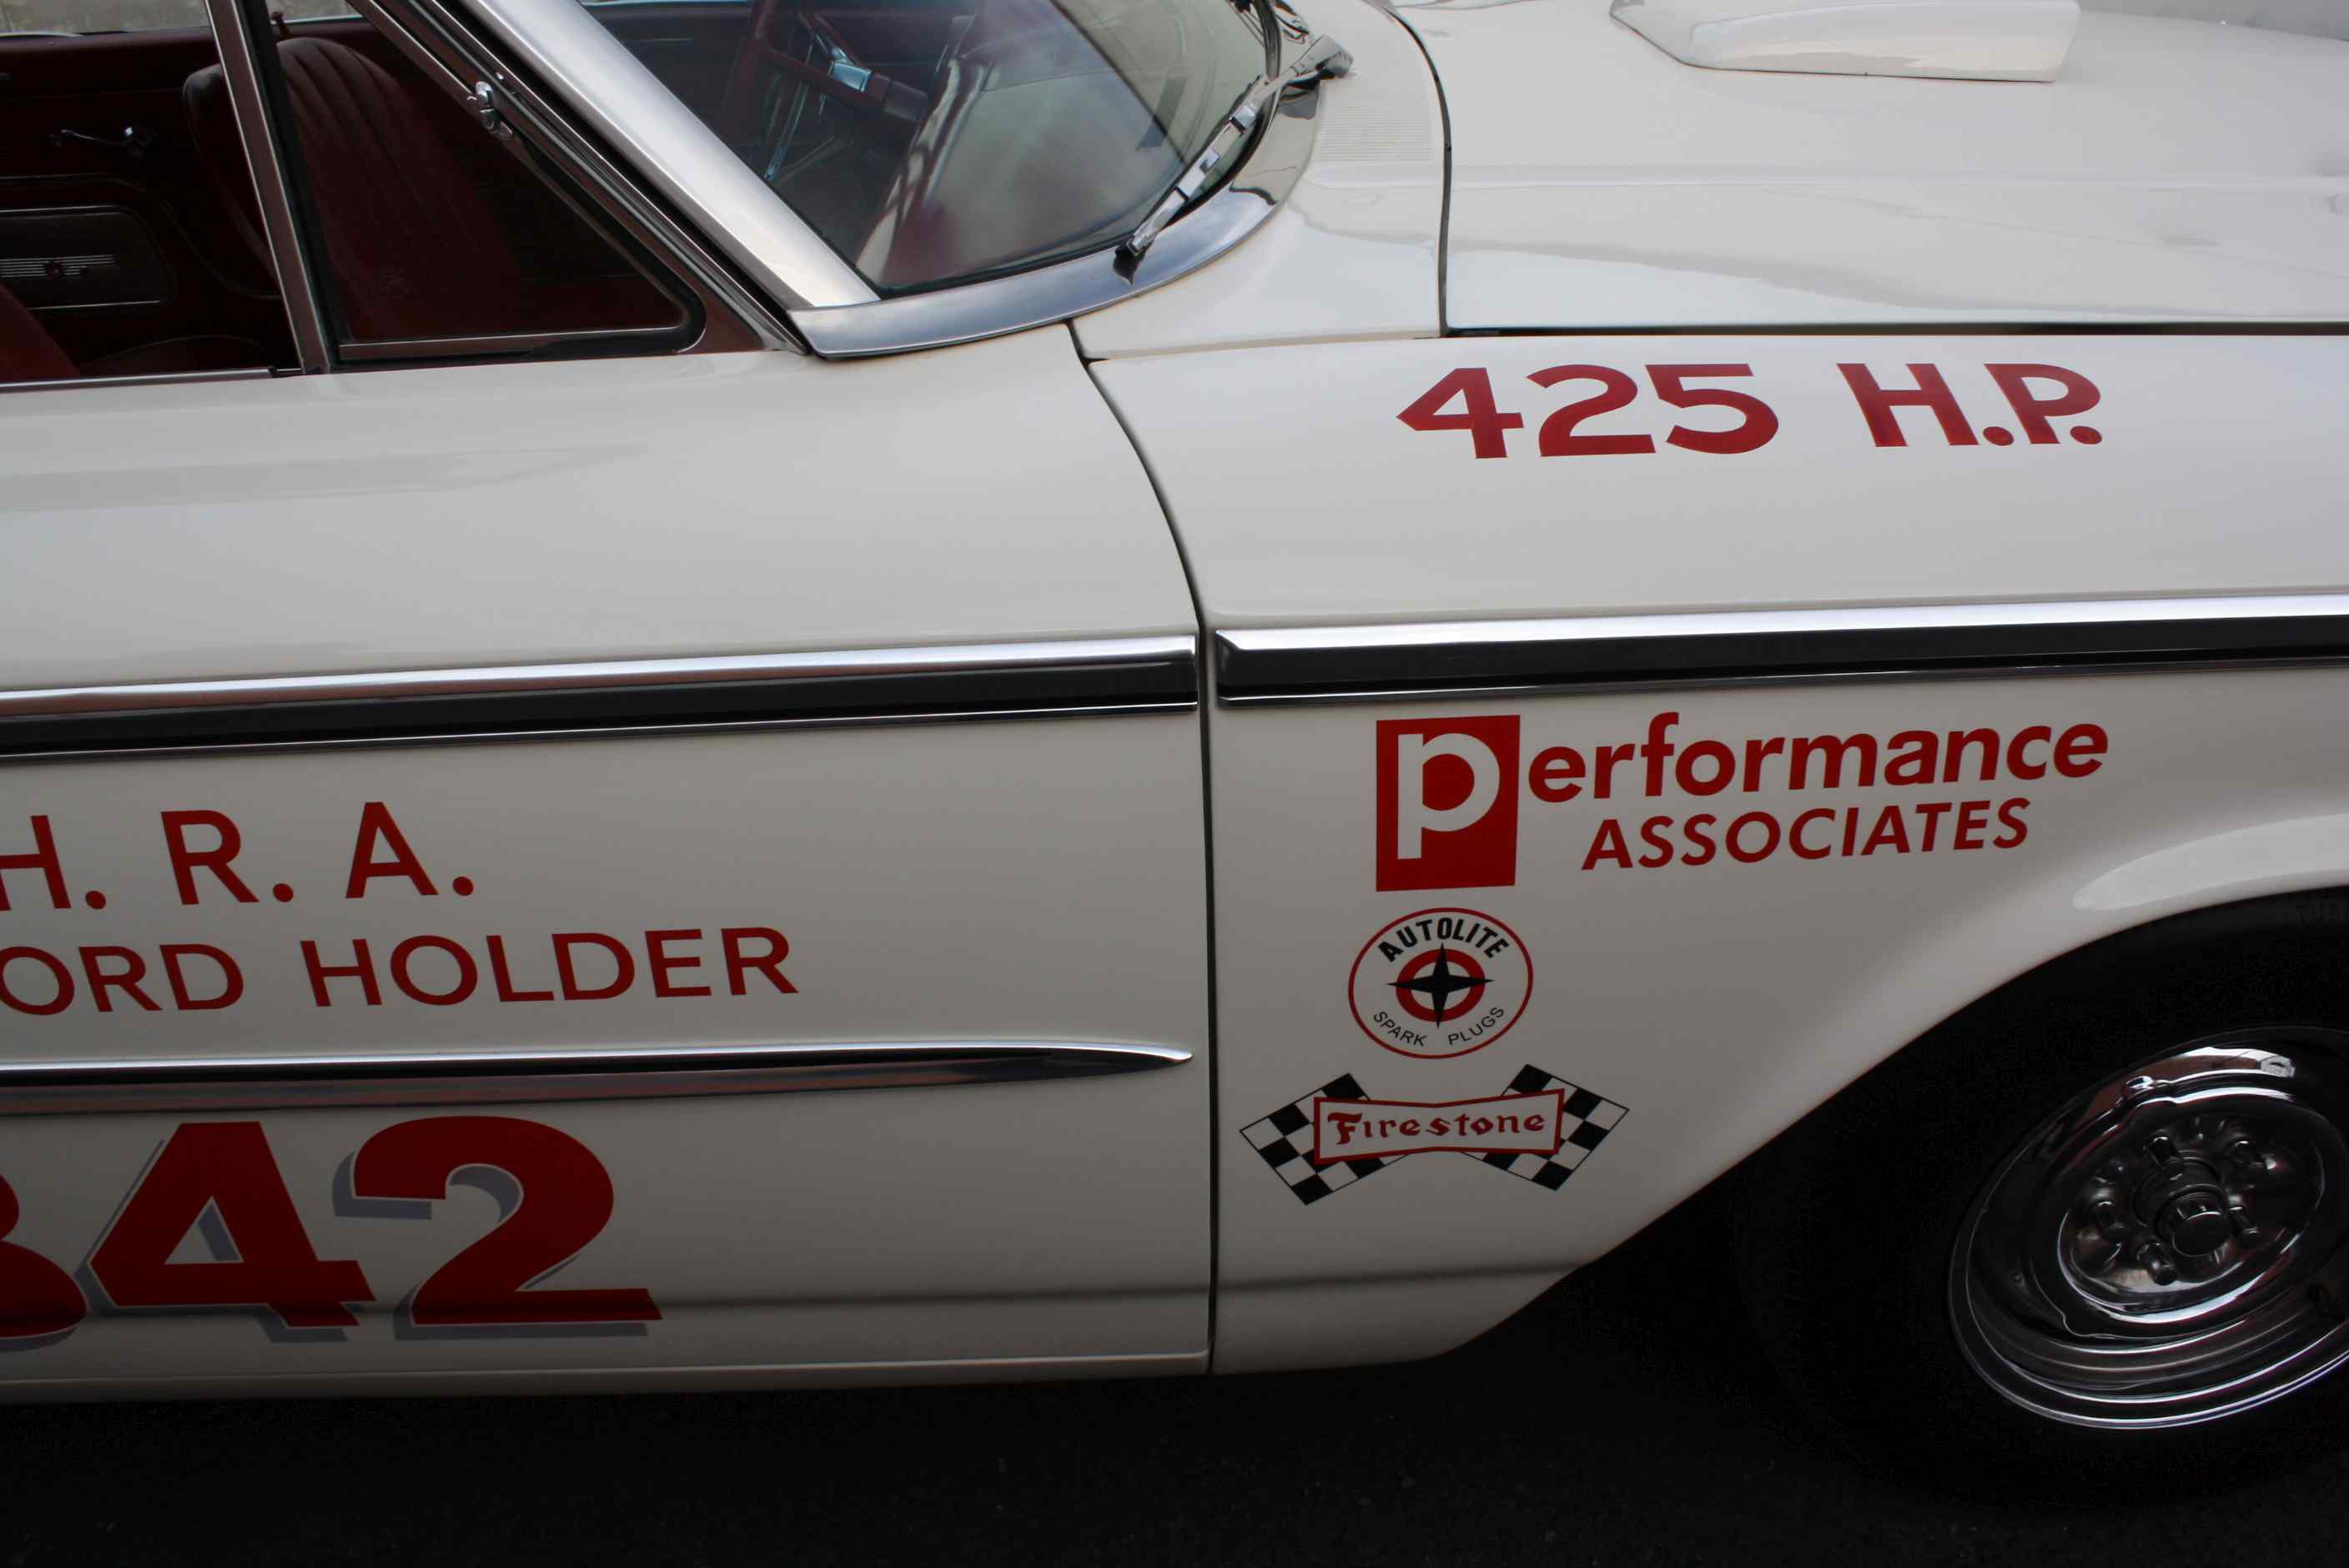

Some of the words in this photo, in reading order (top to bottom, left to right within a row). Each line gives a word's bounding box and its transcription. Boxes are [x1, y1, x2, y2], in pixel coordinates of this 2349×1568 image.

[1398, 364, 1778, 460] 425
[1837, 362, 2103, 449] H.P.
[1396, 711, 2109, 861] performance
[0, 813, 106, 911] H.
[160, 809, 294, 905] R.
[345, 801, 475, 899] A.
[1582, 796, 2030, 871] ASSOCIATES
[0, 943, 245, 1016] ORD
[299, 925, 799, 1008] HOLDER
[1378, 917, 1510, 962] AUTOLITE
[1373, 1011, 1427, 1047] SPARK
[1447, 1007, 1505, 1045] PLUGS
[1326, 1112, 1546, 1145] Firestone
